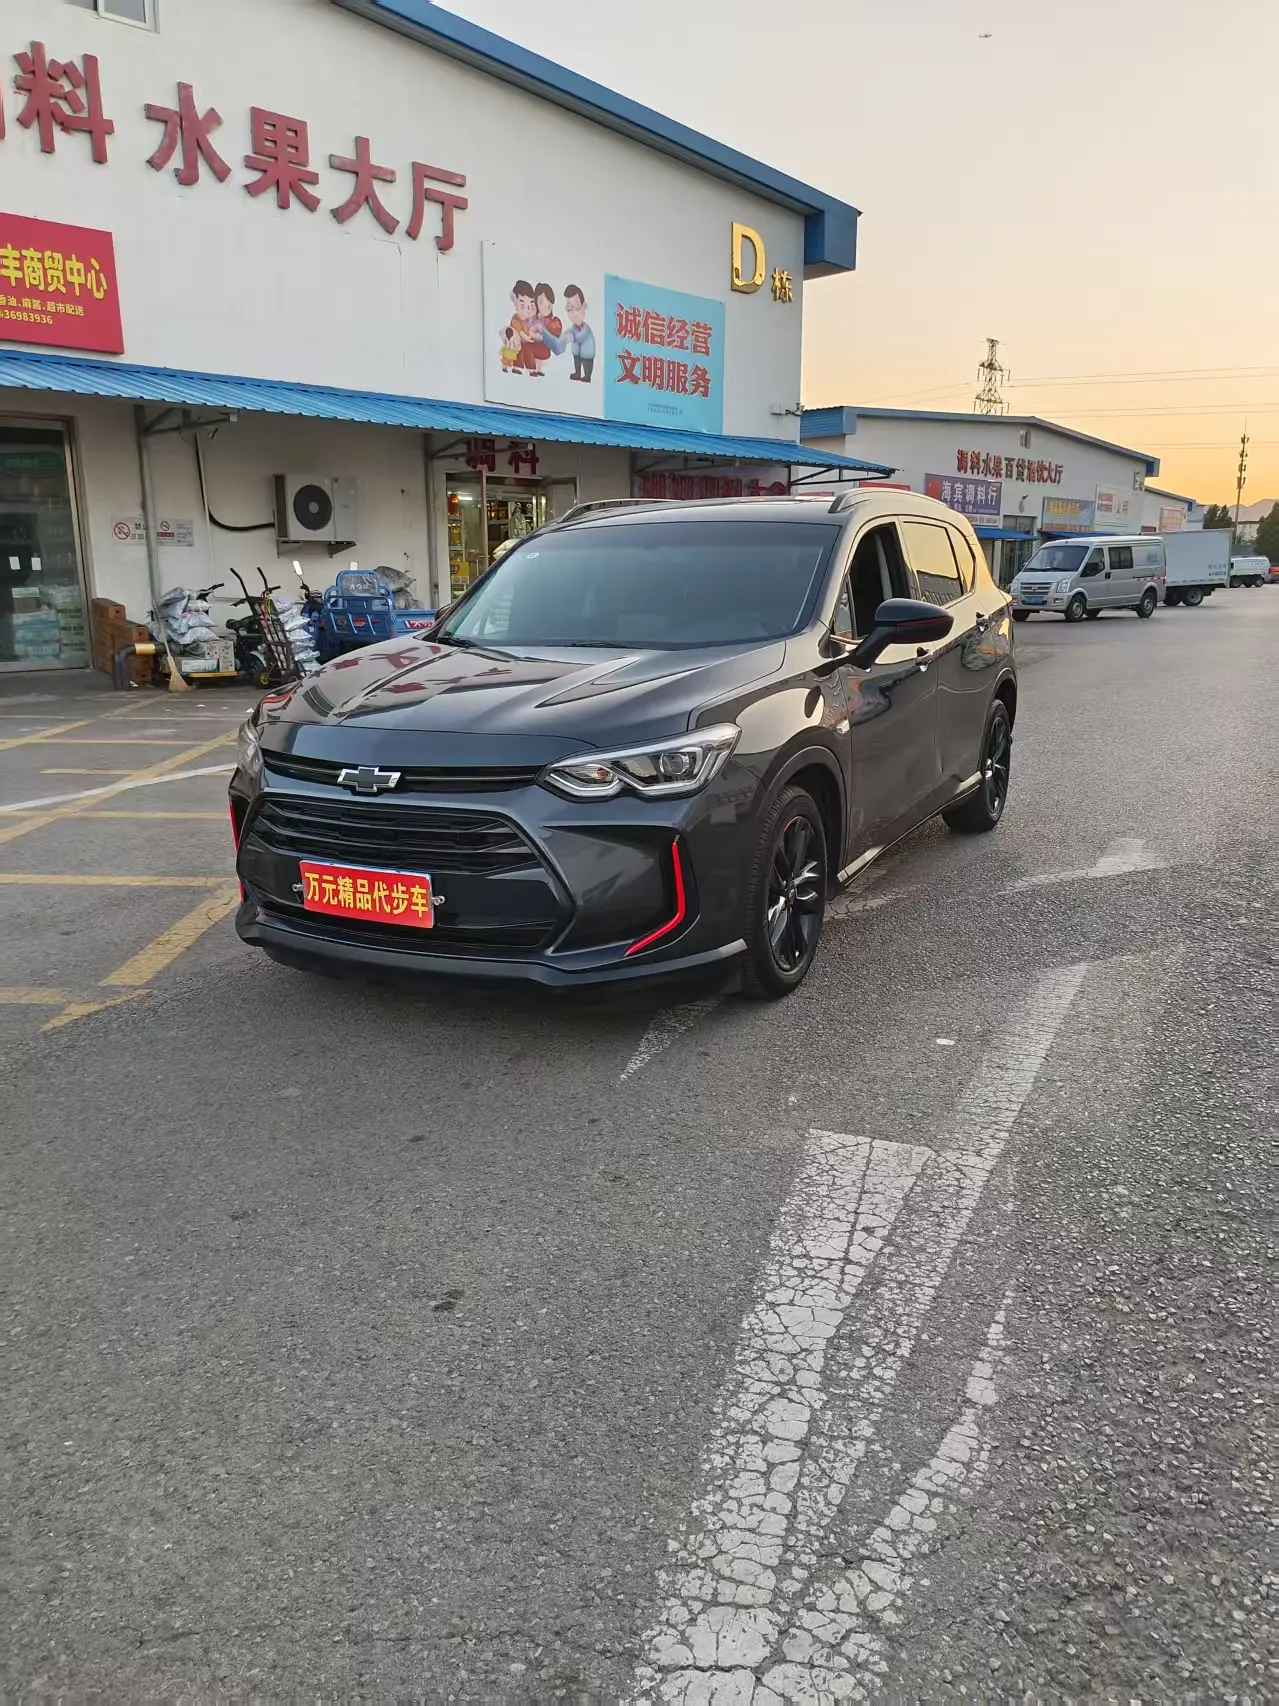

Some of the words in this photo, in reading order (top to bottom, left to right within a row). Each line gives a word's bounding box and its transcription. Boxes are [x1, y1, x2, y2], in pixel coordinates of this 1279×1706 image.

[616, 301, 713, 357] 诚信经营
[616, 348, 711, 398] 文明服务
[941, 480, 997, 506] 海宾调料行
[304, 871, 429, 918] 万元精品代步车
